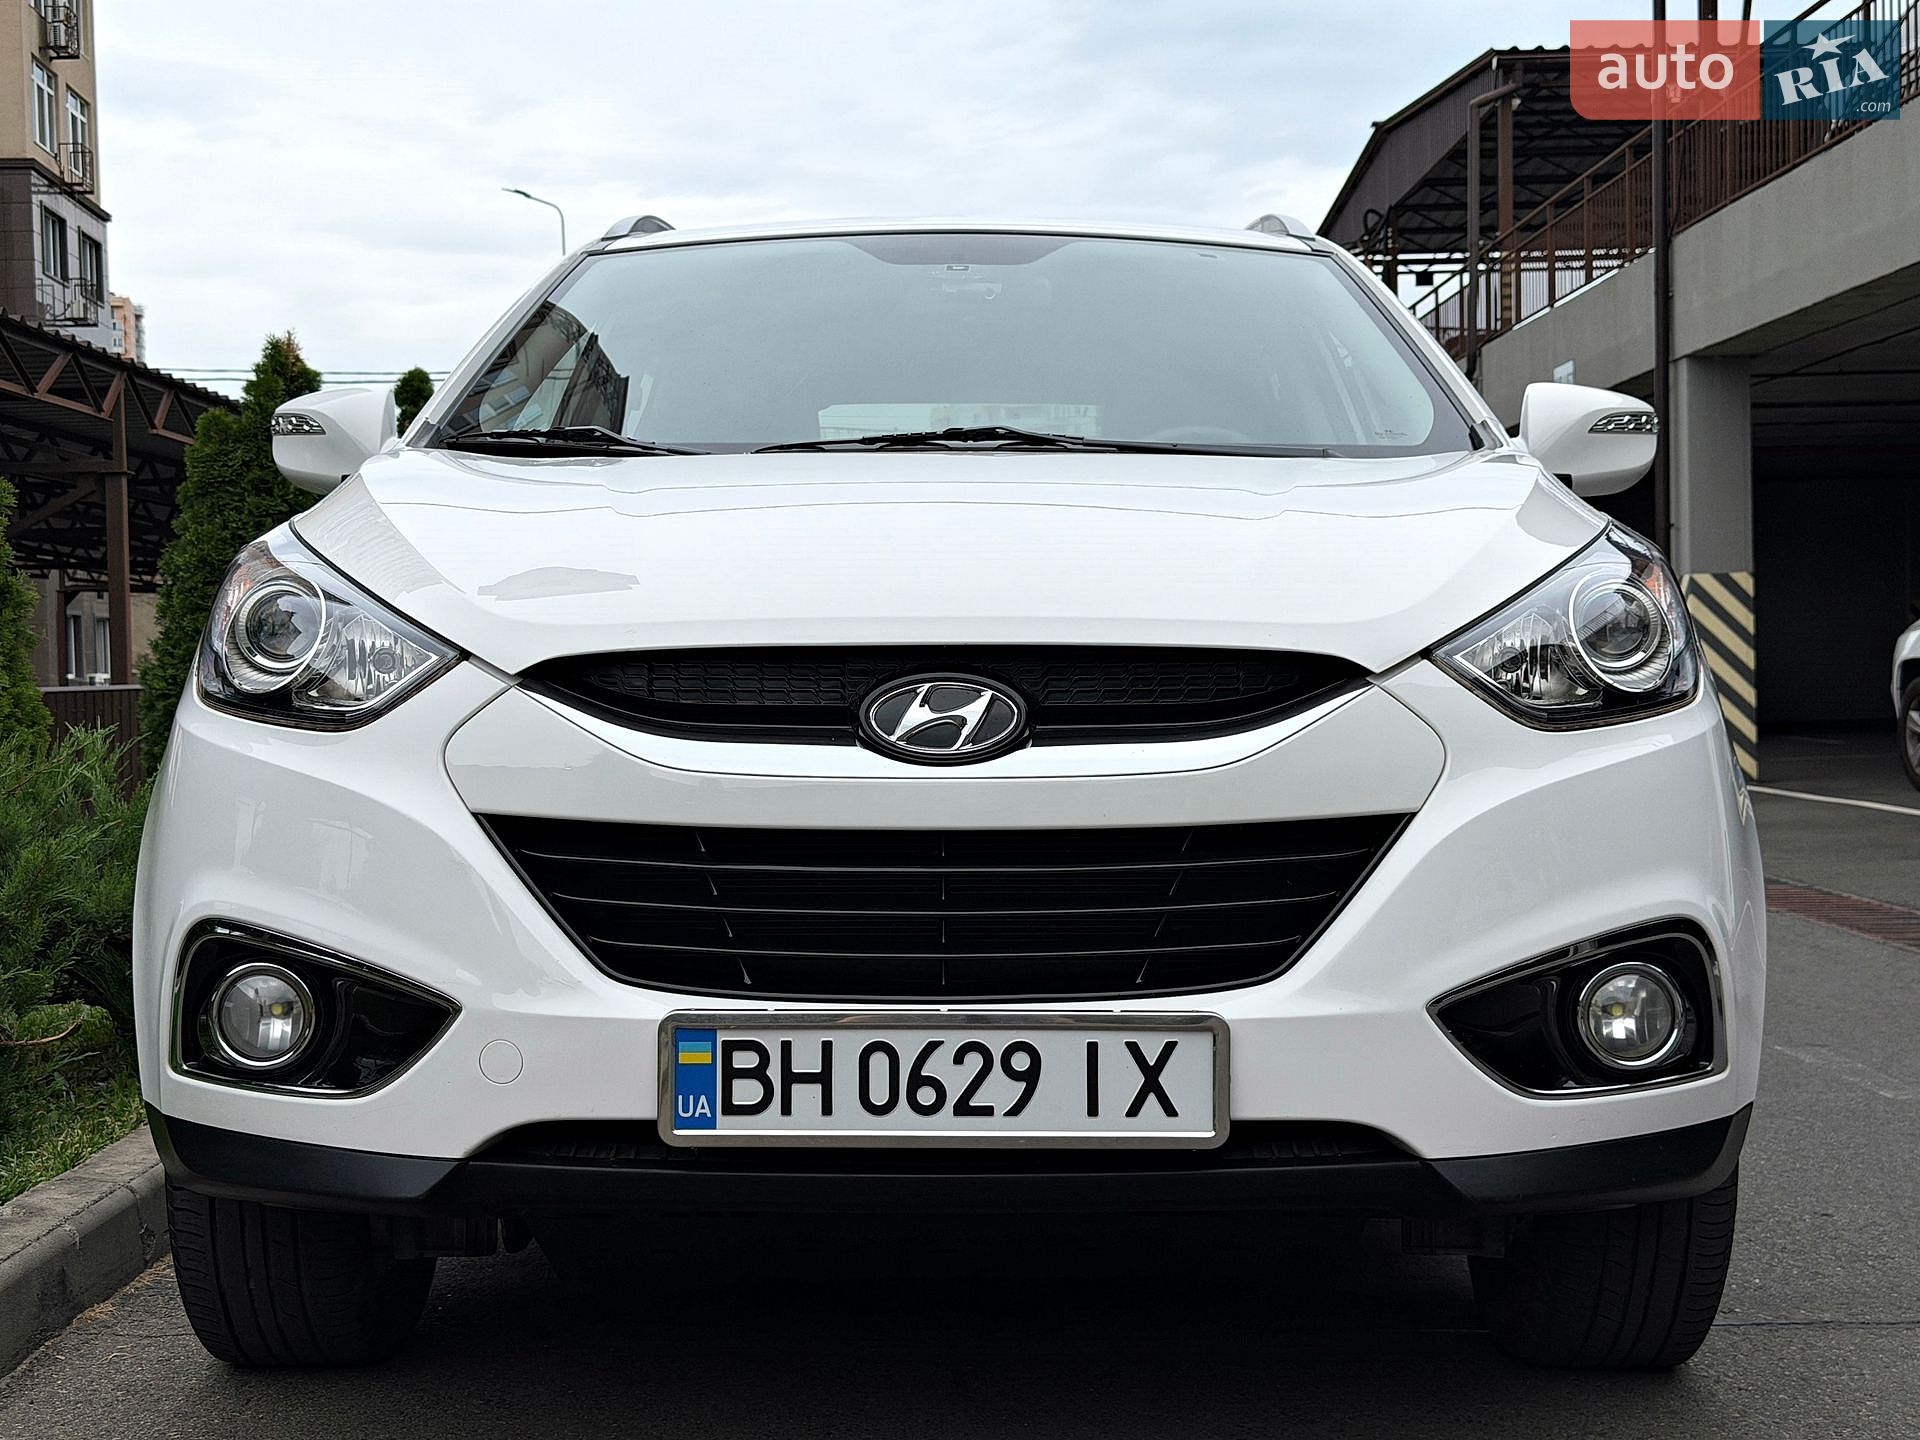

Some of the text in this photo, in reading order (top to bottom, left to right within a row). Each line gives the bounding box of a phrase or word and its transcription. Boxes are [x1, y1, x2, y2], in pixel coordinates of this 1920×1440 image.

[721, 1039, 834, 1117] BH
[857, 1039, 1042, 1117] 0629
[678, 1095, 711, 1118] UA
